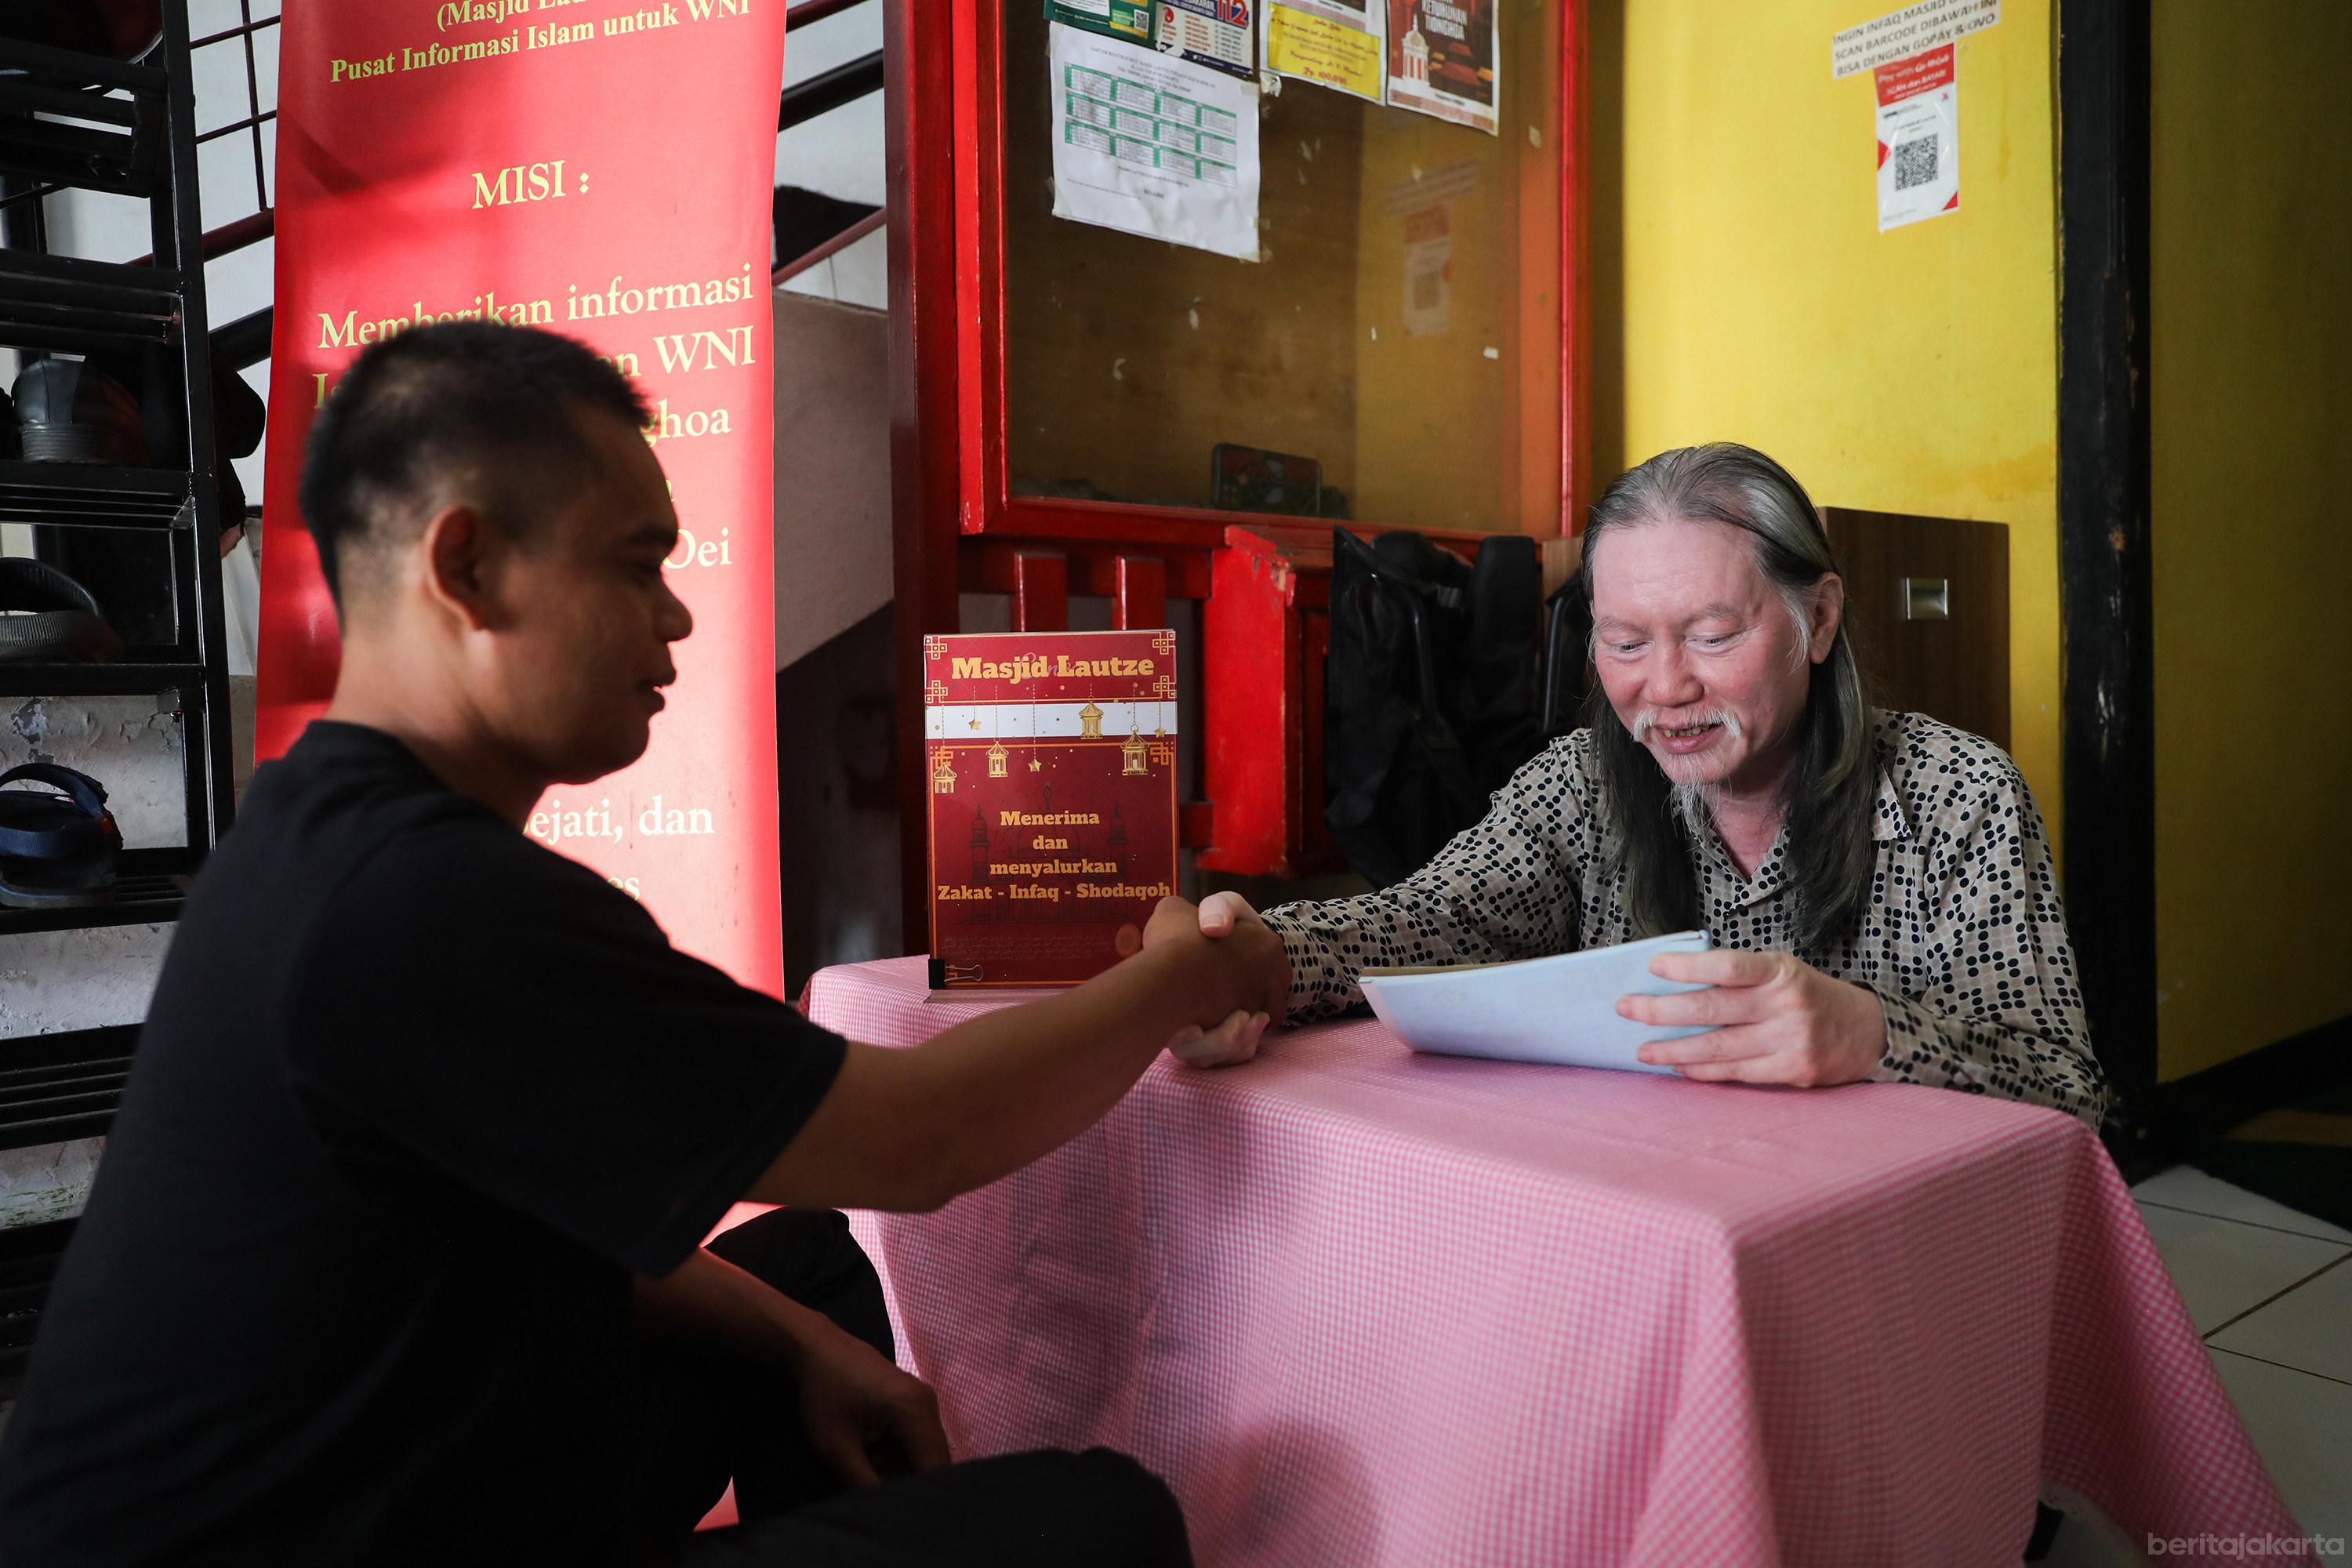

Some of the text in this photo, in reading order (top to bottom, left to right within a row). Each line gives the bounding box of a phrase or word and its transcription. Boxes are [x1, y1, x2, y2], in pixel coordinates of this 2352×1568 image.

[1217, 0, 1248, 27] 112
[1832, 0, 1946, 45] INGIN INFAQ MASJID
[330, 0, 751, 82] Pusat Informasi Islam untuk WNI
[1835, 44, 1863, 60] SCAN
[1865, 24, 1917, 51] BARCODE
[1836, 13, 1995, 76] BISA DENGAN GOPAY & OVO
[471, 160, 590, 209] MISI :
[566, 263, 754, 321] informasi
[653, 325, 757, 374] WNI
[951, 655, 1155, 684] Masjid Lautze
[523, 794, 716, 845] ejati, dan
[1000, 811, 1100, 826] Menerima
[1033, 835, 1069, 850] dan
[989, 859, 1117, 877] menyalurkan
[938, 884, 993, 900] Zakat
[1009, 884, 1059, 902] Infaq
[1076, 882, 1171, 901] Shodaqoh
